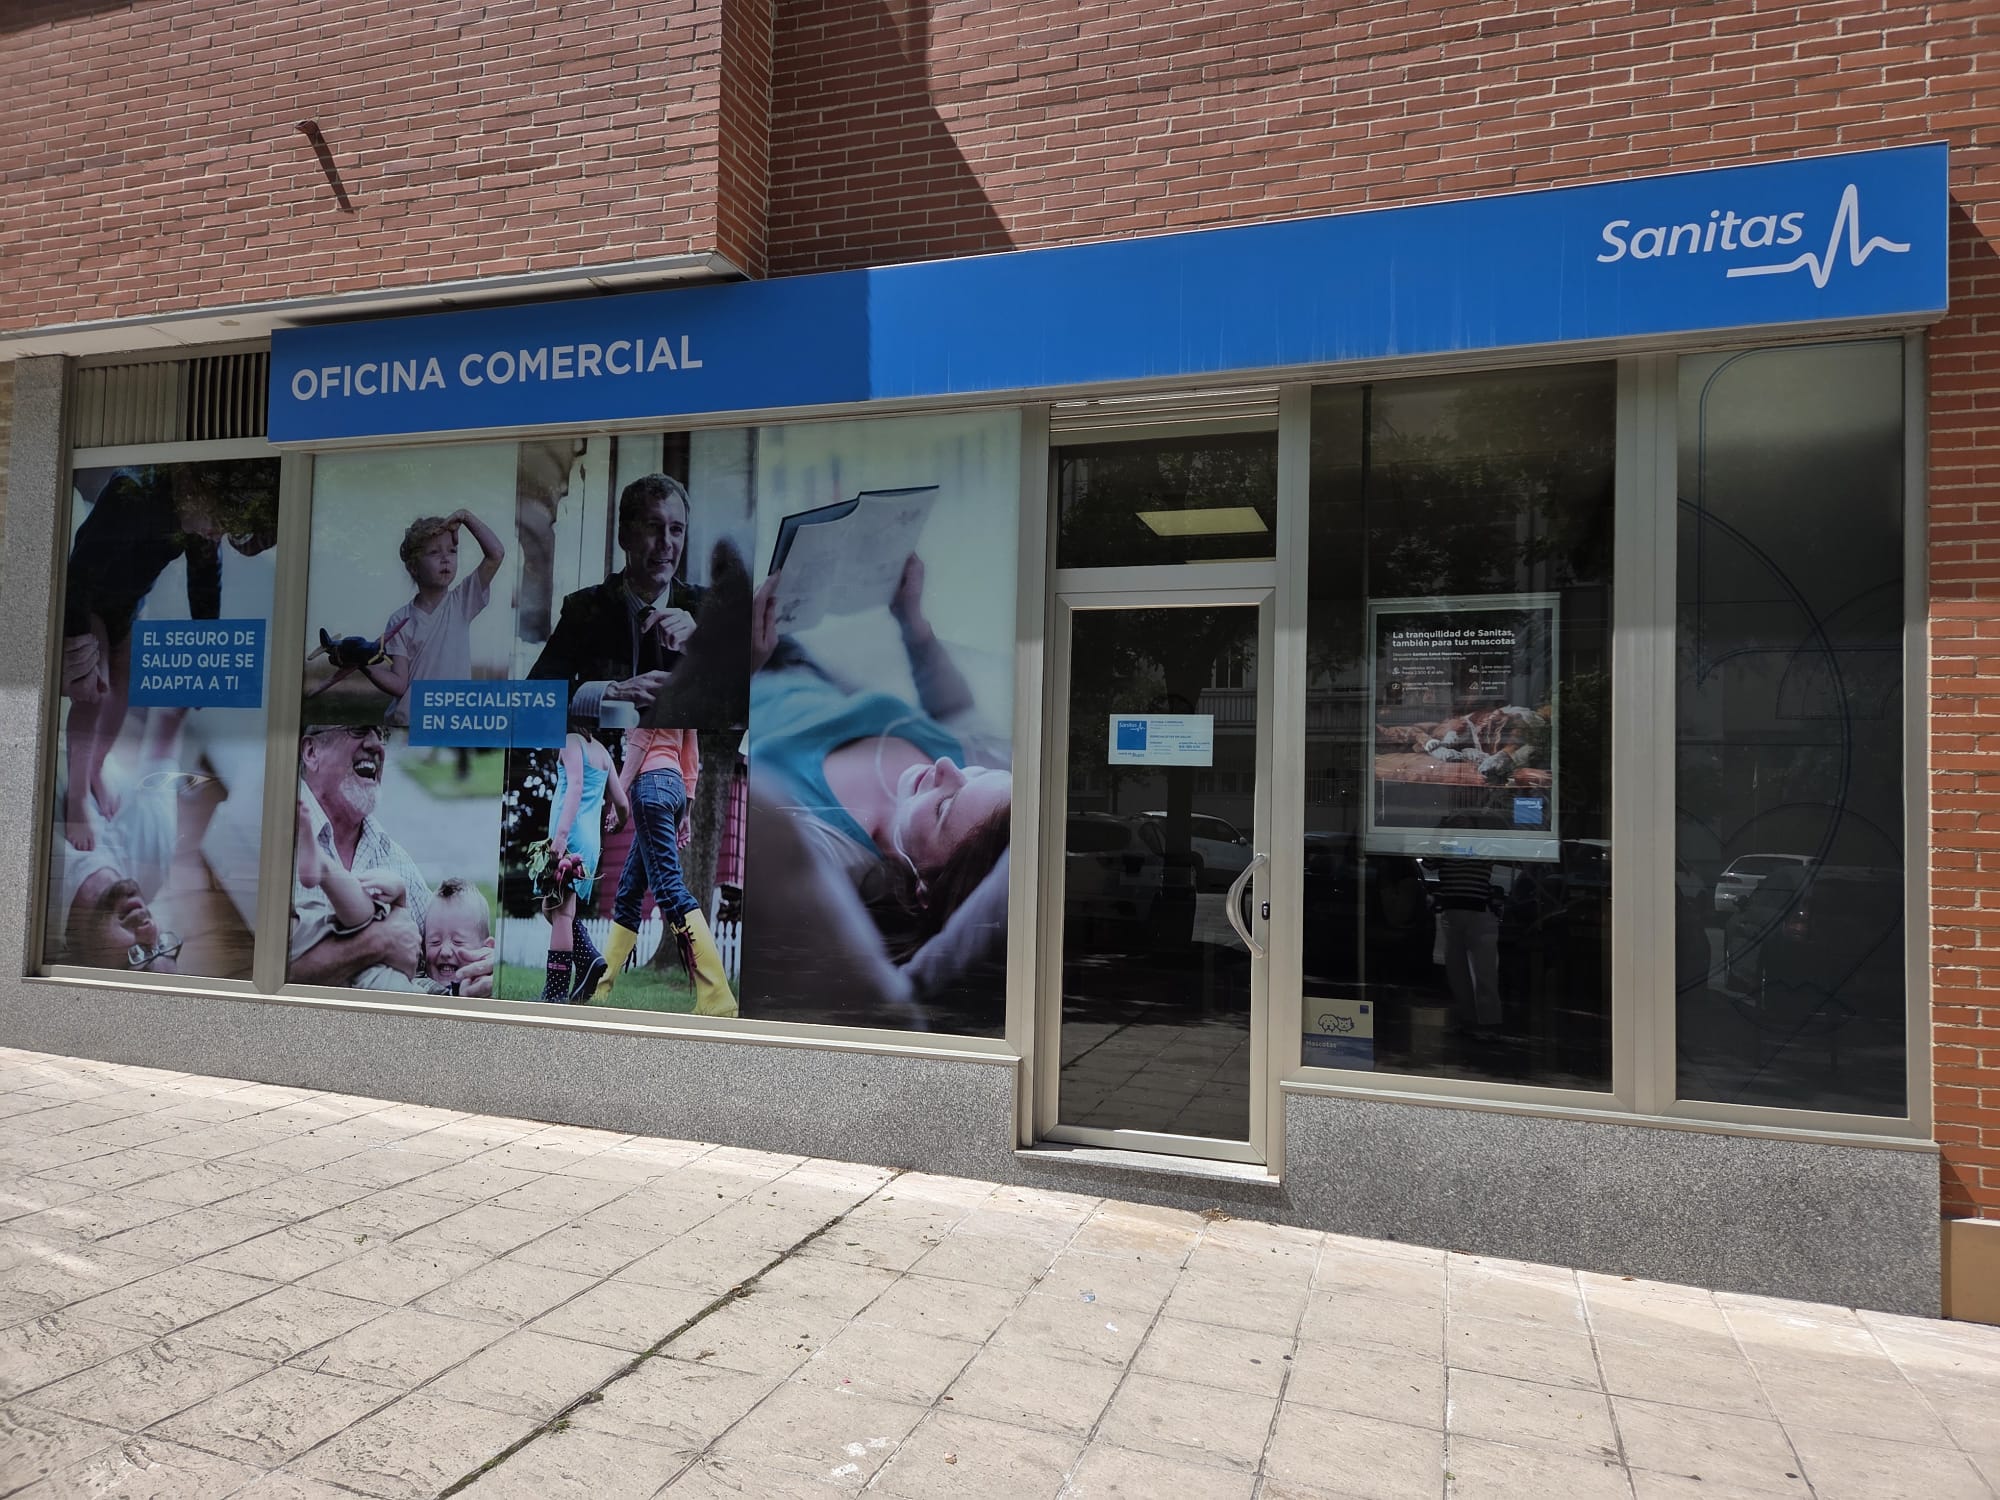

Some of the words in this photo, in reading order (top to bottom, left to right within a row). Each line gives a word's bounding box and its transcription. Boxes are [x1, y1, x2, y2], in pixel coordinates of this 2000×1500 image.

[1596, 209, 1805, 263] Sanitas
[291, 357, 446, 401] OFICINA
[459, 334, 703, 387] COMERCIAL
[143, 631, 161, 646] EL
[165, 631, 229, 646] SEGURO
[234, 631, 256, 646] DE
[1392, 631, 1404, 639] La
[1405, 630, 1461, 640] tranquilidad
[1463, 629, 1475, 637] de
[1477, 628, 1515, 639] Sanitas,
[1392, 639, 1430, 647] también
[1431, 639, 1452, 648] para
[1454, 638, 1469, 646] tus
[1471, 637, 1516, 646] mascotas
[142, 653, 193, 668] SALUD
[197, 653, 231, 668] QUE
[234, 653, 255, 668] SE
[140, 675, 204, 690] ADAPTA
[208, 675, 220, 690] A
[224, 675, 240, 690] TI
[423, 691, 556, 708] ESPECIALISTAS
[422, 714, 445, 730] EN
[450, 714, 508, 731] SALUD
